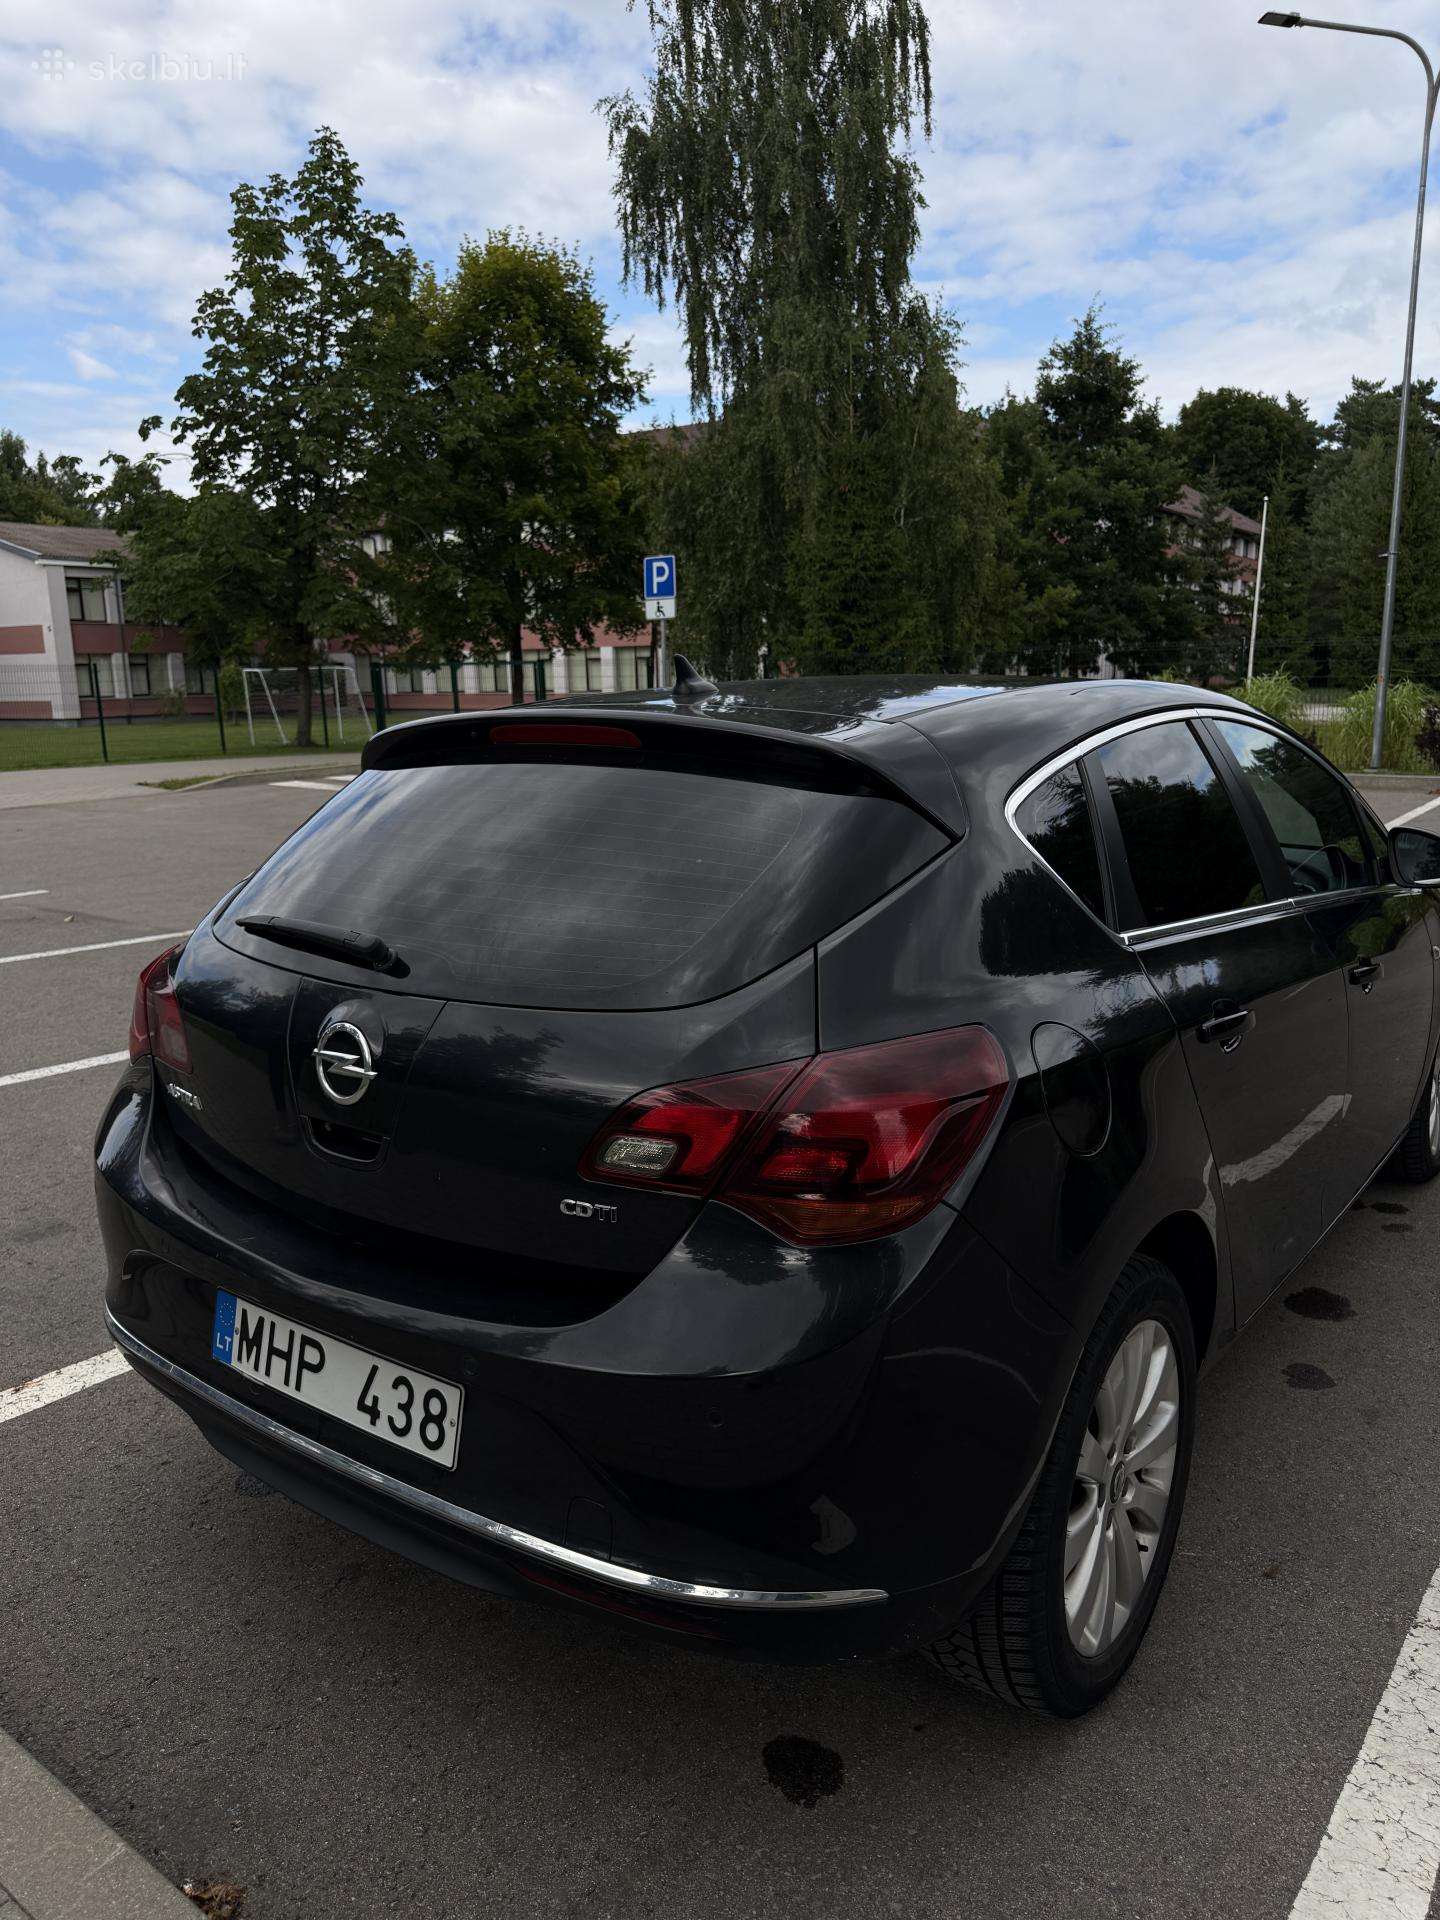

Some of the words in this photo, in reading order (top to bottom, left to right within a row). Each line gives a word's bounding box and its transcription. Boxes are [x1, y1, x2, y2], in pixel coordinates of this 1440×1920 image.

[652, 561, 669, 594] P
[560, 1199, 617, 1222] CDTI
[216, 1332, 232, 1352] LT
[237, 1308, 326, 1392] MHP
[356, 1364, 448, 1451] 438
